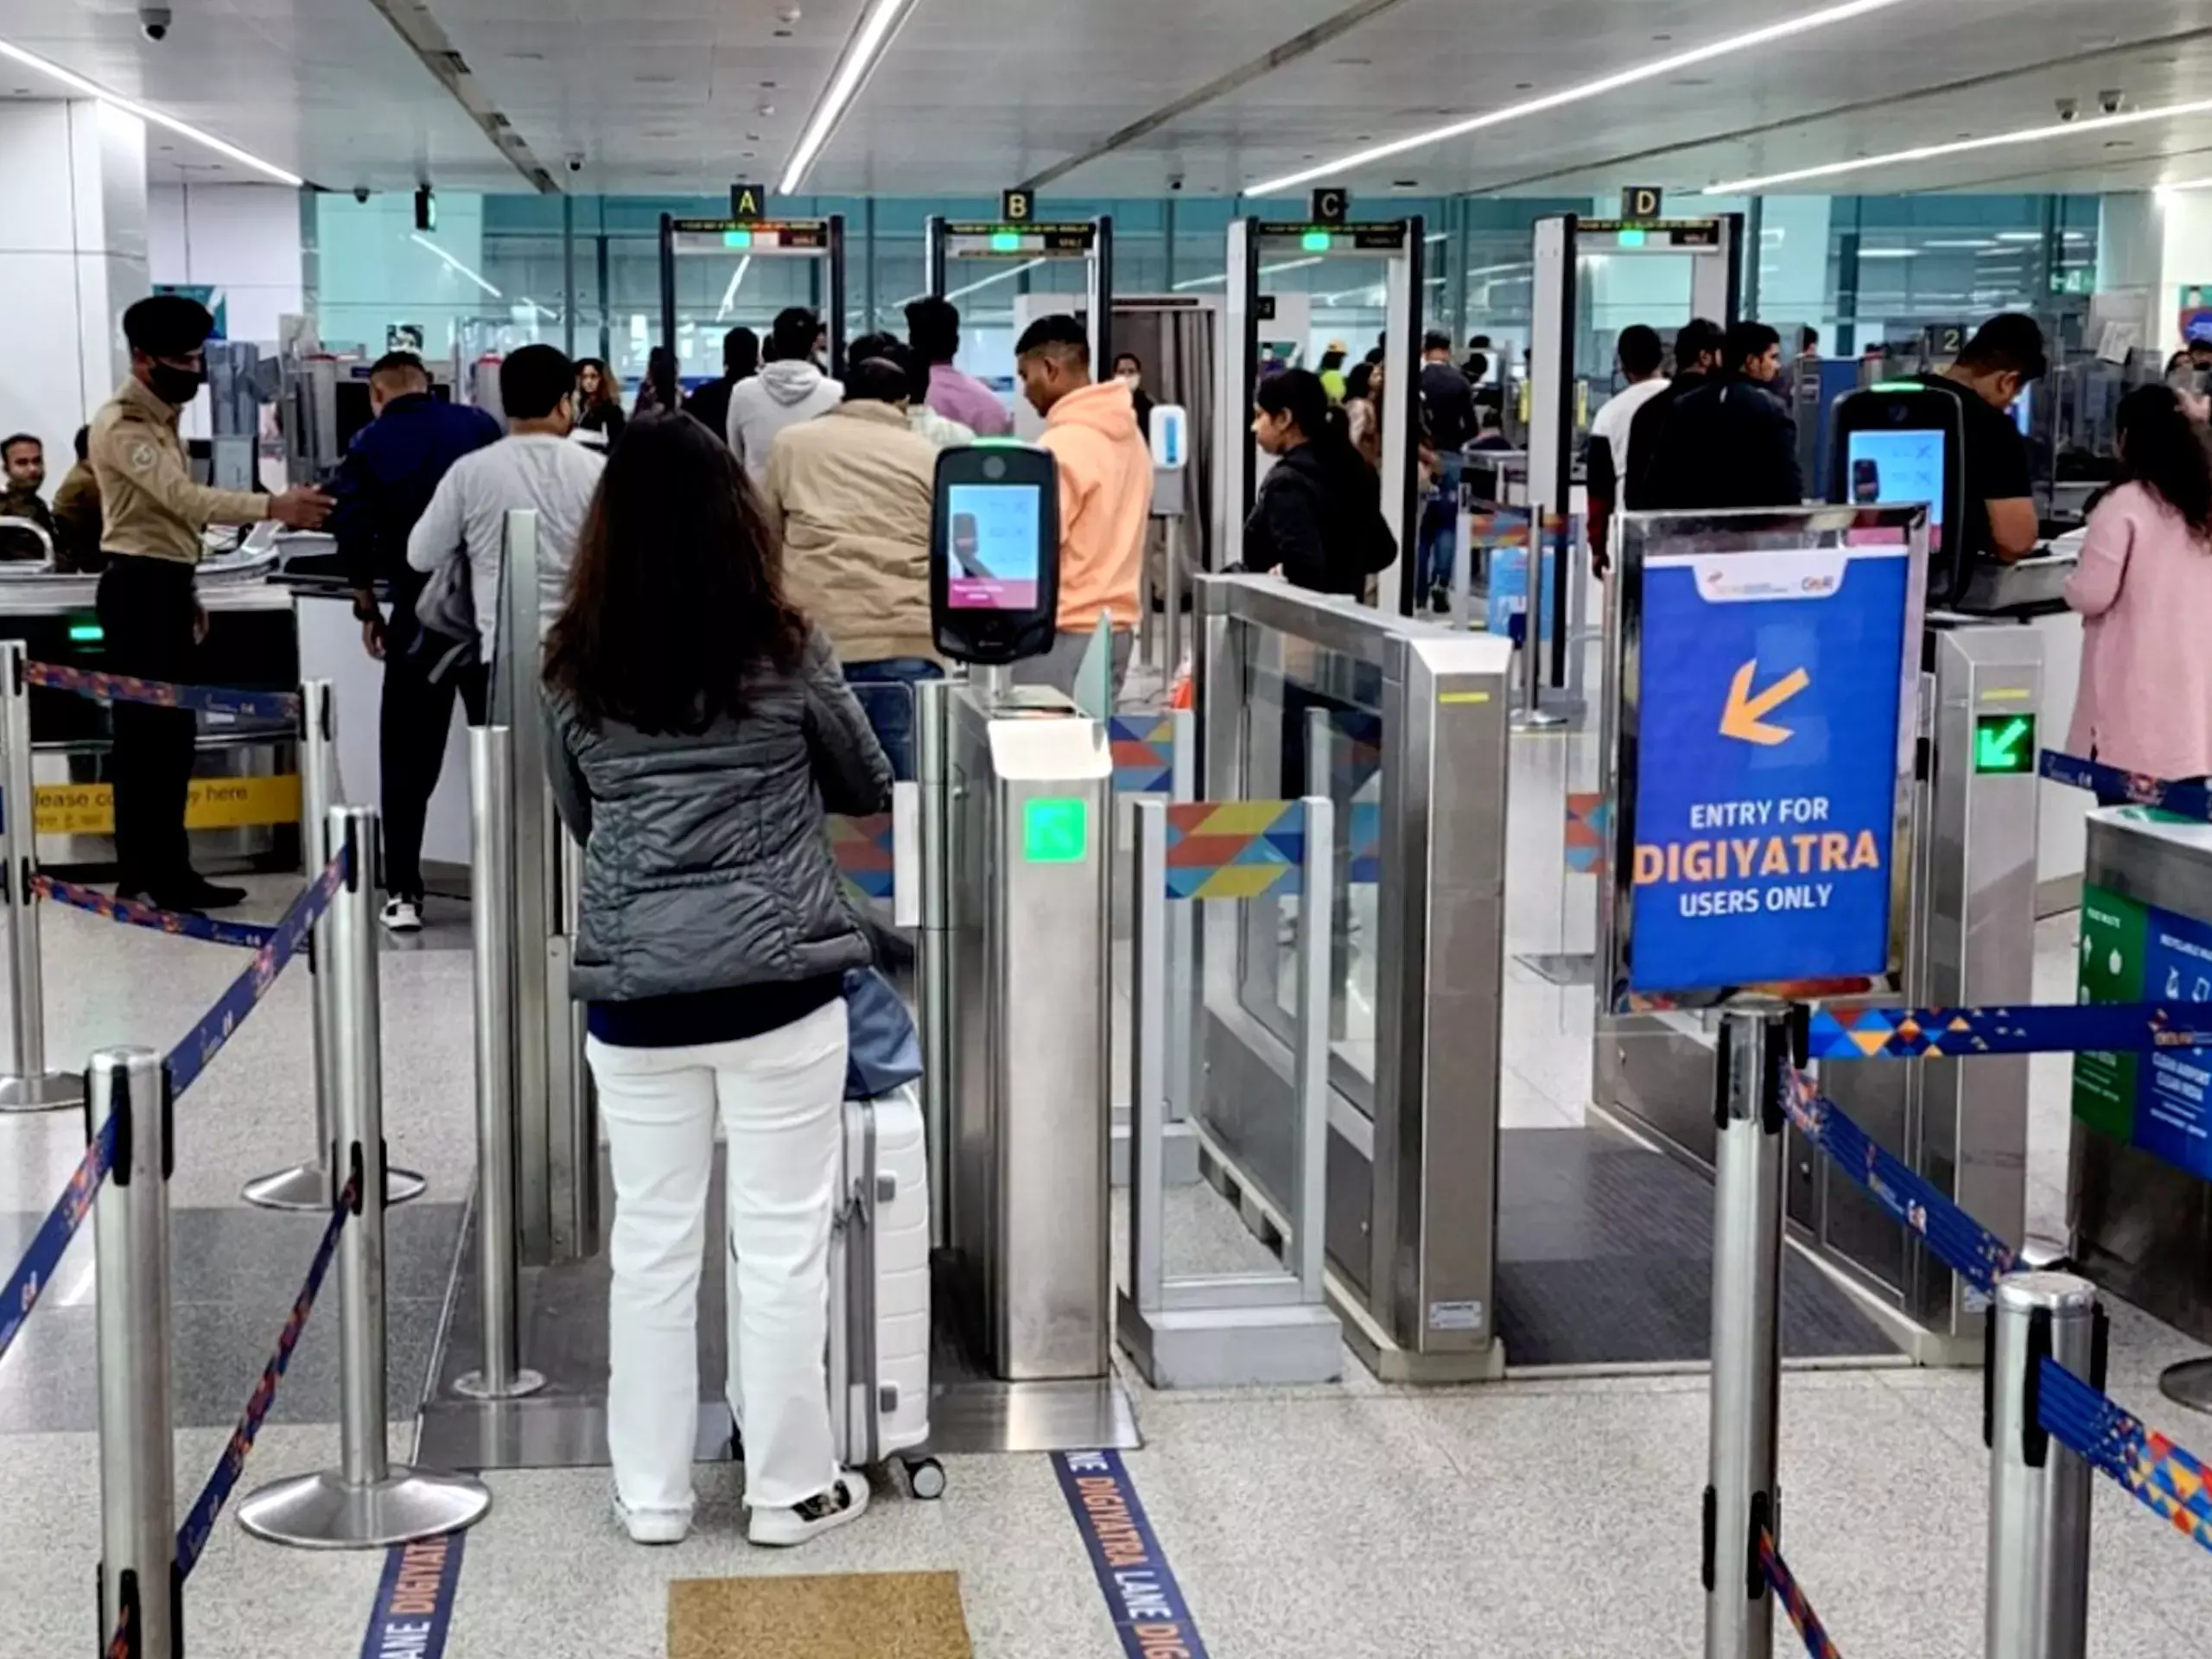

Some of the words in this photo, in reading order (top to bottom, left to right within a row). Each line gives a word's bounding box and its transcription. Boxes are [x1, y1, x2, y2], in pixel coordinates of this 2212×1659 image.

[739, 189, 757, 214] A
[1008, 193, 1028, 218] B
[1320, 193, 1339, 217] C
[1637, 190, 1656, 214] D
[1943, 328, 1960, 351] 2
[206, 785, 248, 802] here
[1689, 800, 1772, 830] ENTRY
[1779, 796, 1829, 823] FOR
[1633, 829, 1880, 886] DIGIYATRA
[1679, 887, 1760, 918] USERS
[1765, 883, 1834, 912] ONLY
[1075, 1477, 1149, 1567] DIGIYATRA
[1114, 1570, 1173, 1620] LANE
[378, 1620, 431, 1659] ANE
[1134, 1624, 1192, 1659] DIG
